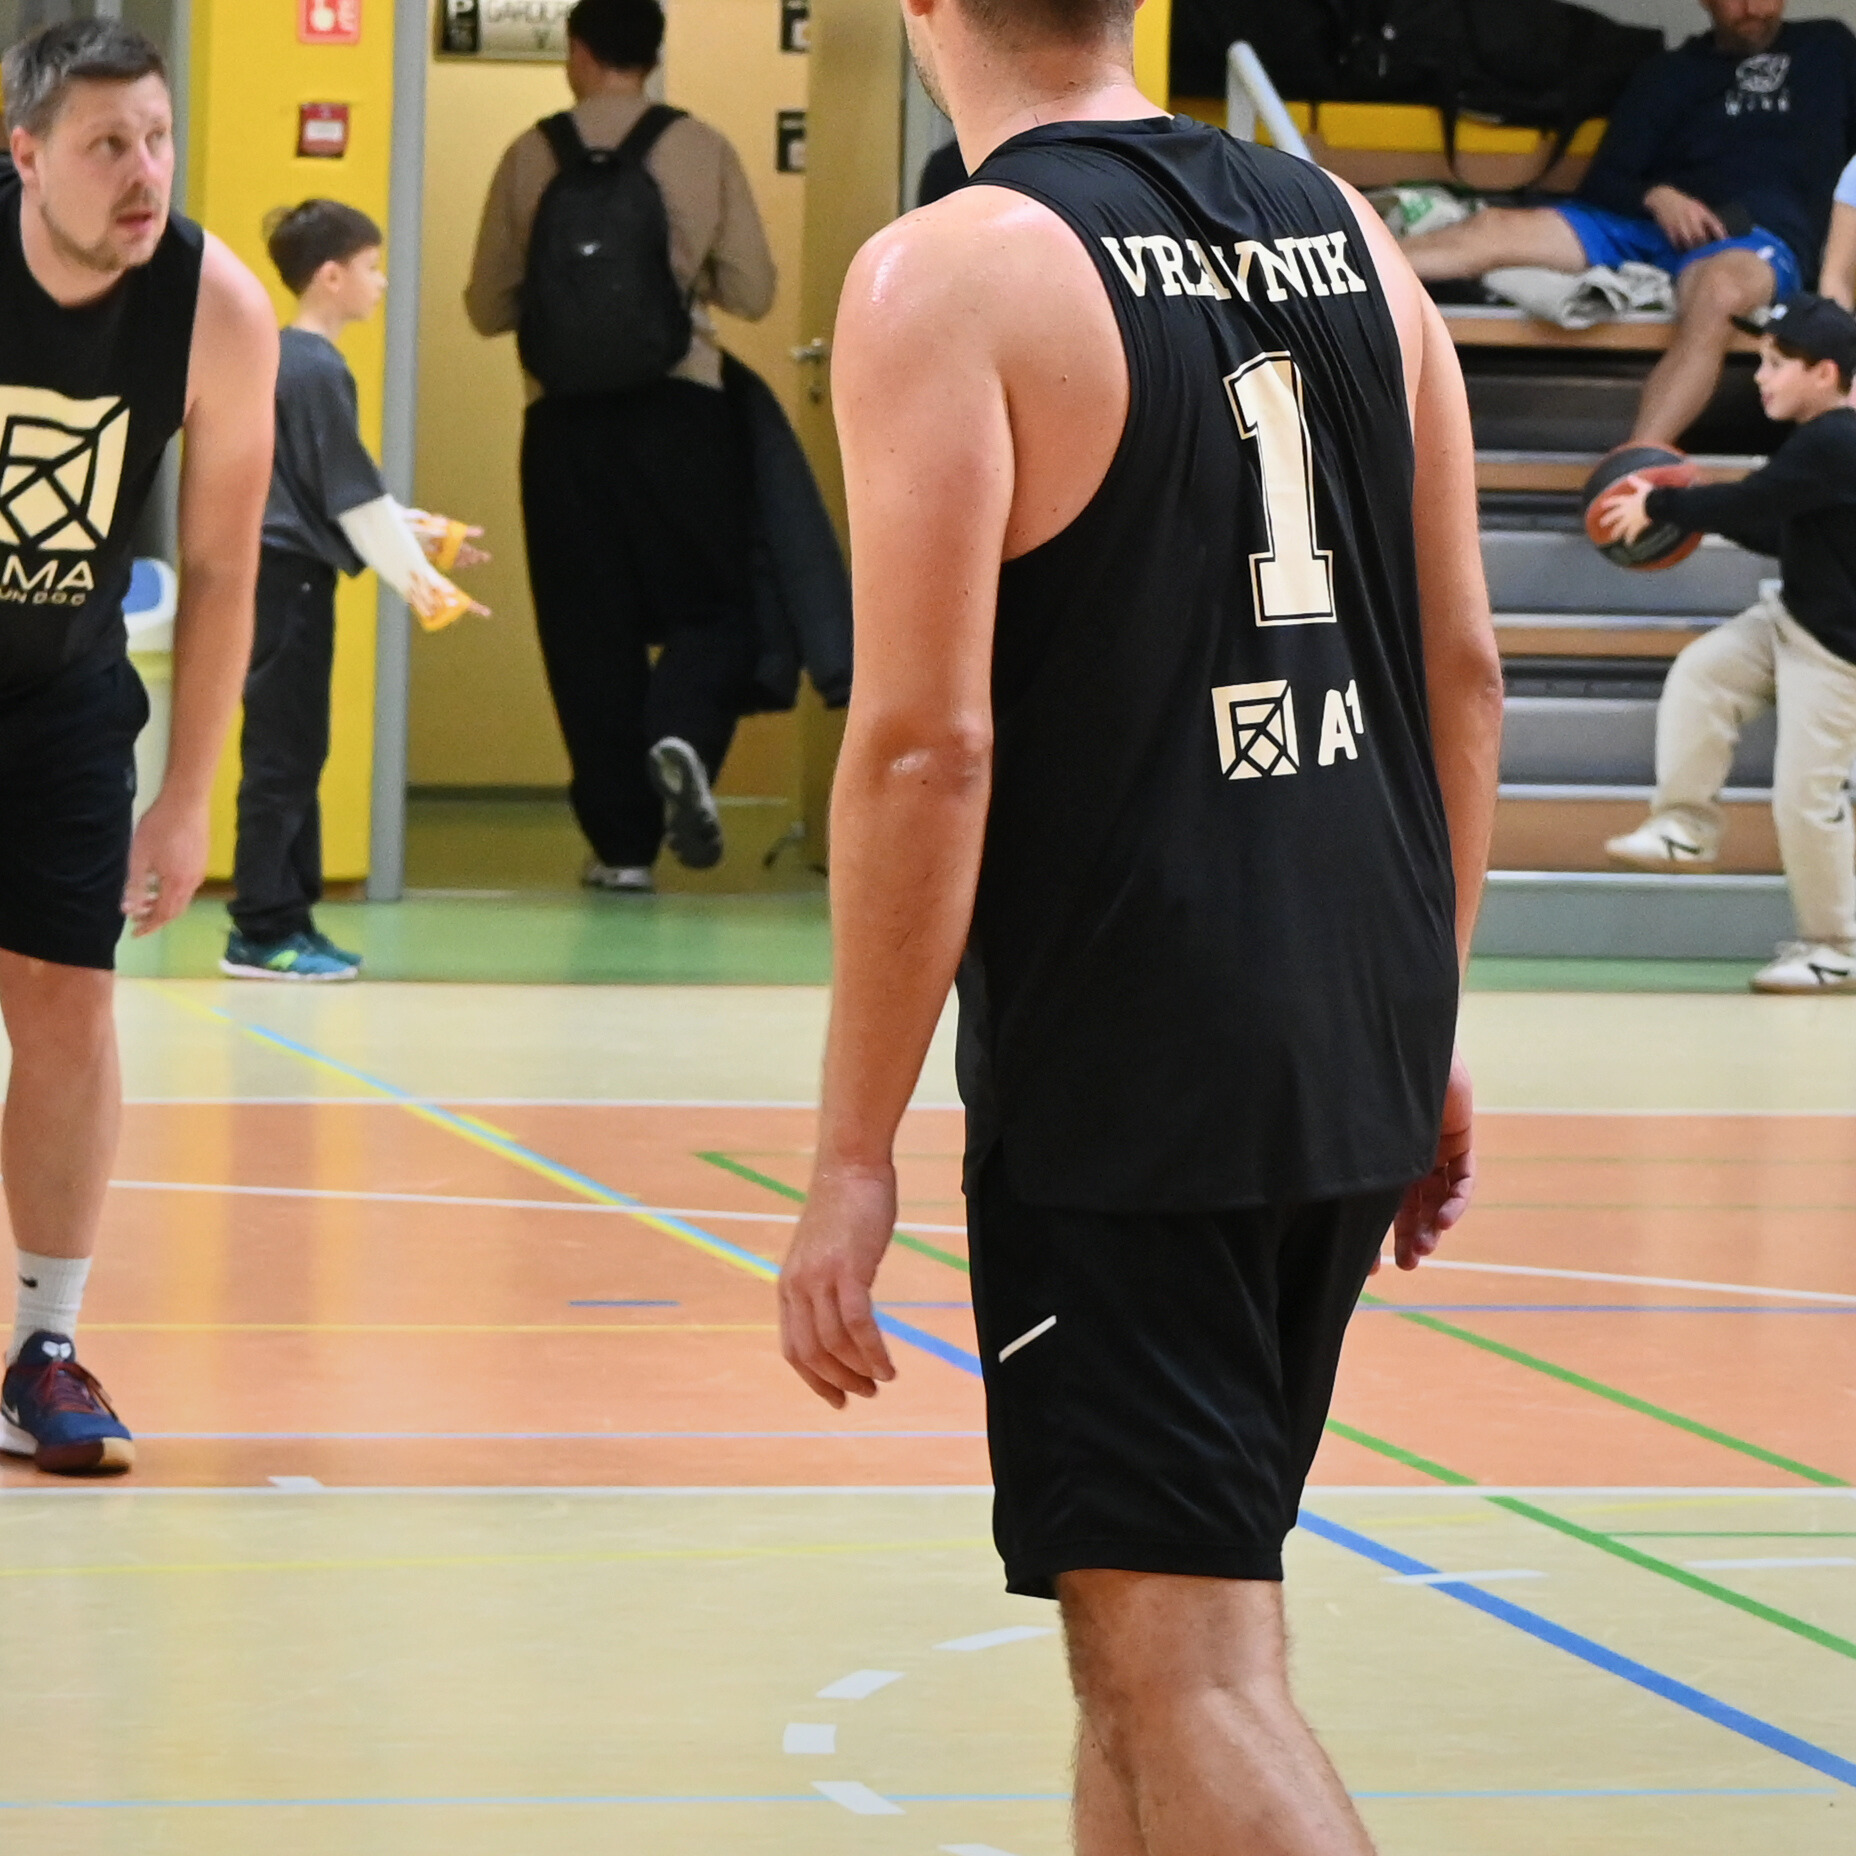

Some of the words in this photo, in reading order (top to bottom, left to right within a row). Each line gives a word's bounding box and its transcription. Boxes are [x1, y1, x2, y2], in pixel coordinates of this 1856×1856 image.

[1100, 230, 1368, 302] VRAVNIK
[1223, 351, 1338, 627] 1
[1318, 679, 1364, 766] A1
